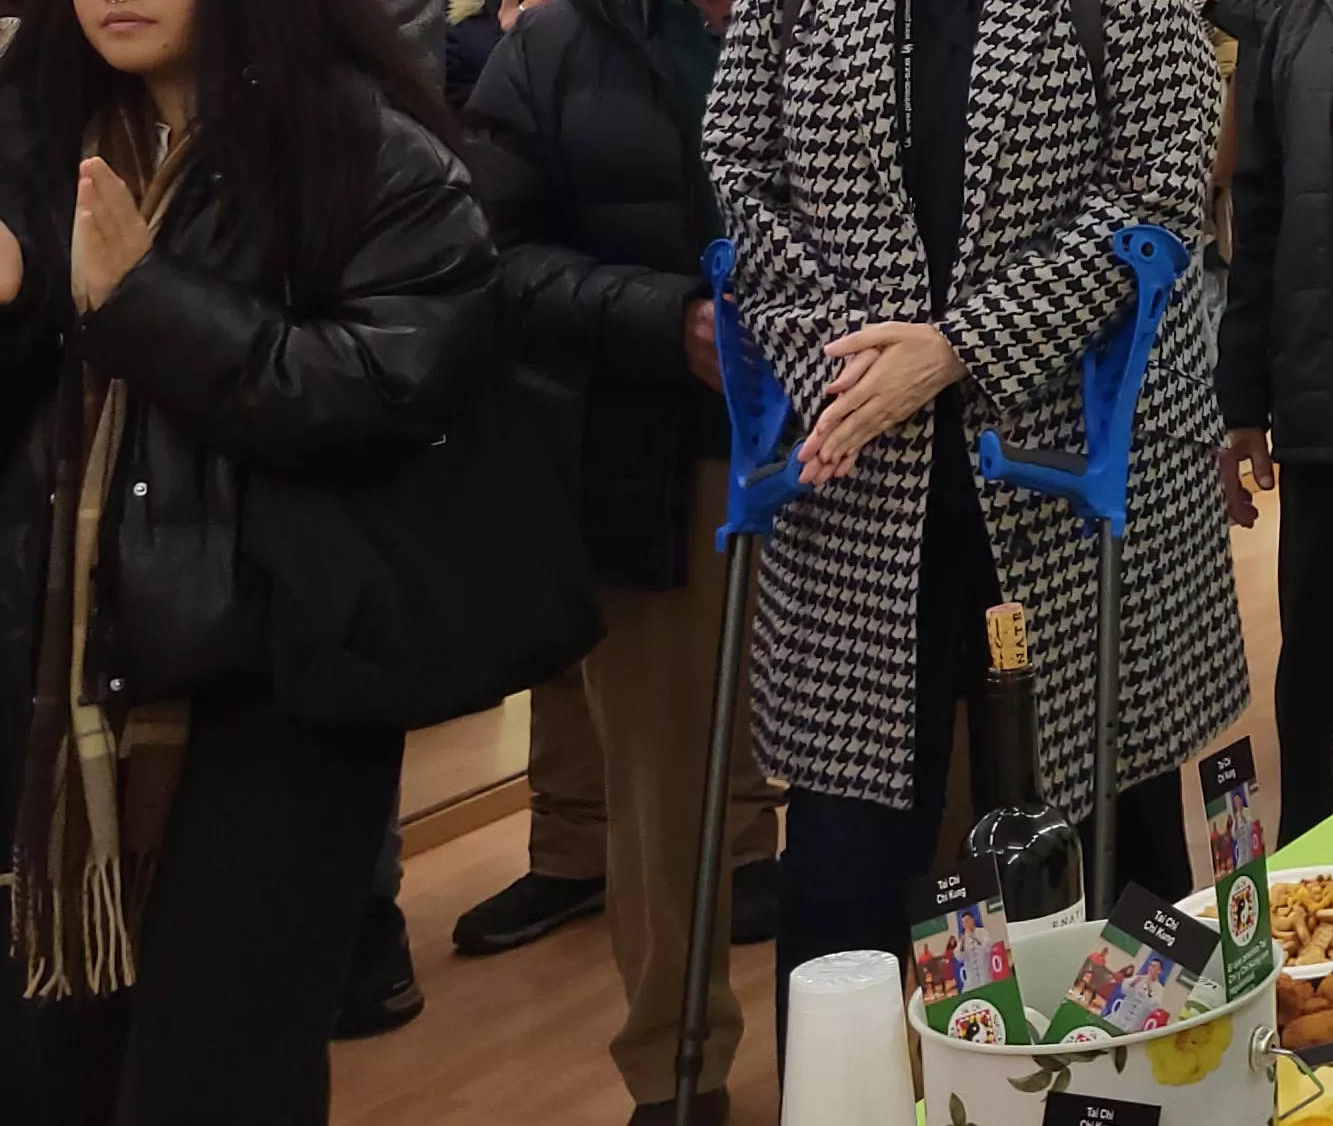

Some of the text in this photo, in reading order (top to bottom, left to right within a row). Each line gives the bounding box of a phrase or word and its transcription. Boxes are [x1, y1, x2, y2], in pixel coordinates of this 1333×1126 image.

[937, 873, 960, 890] Tai Chi
[936, 886, 967, 904] Chi Kung
[1154, 909, 1180, 931] Tai Chi
[1143, 920, 1176, 947] Chi Kung
[1086, 1106, 1115, 1121] Tai Chi
